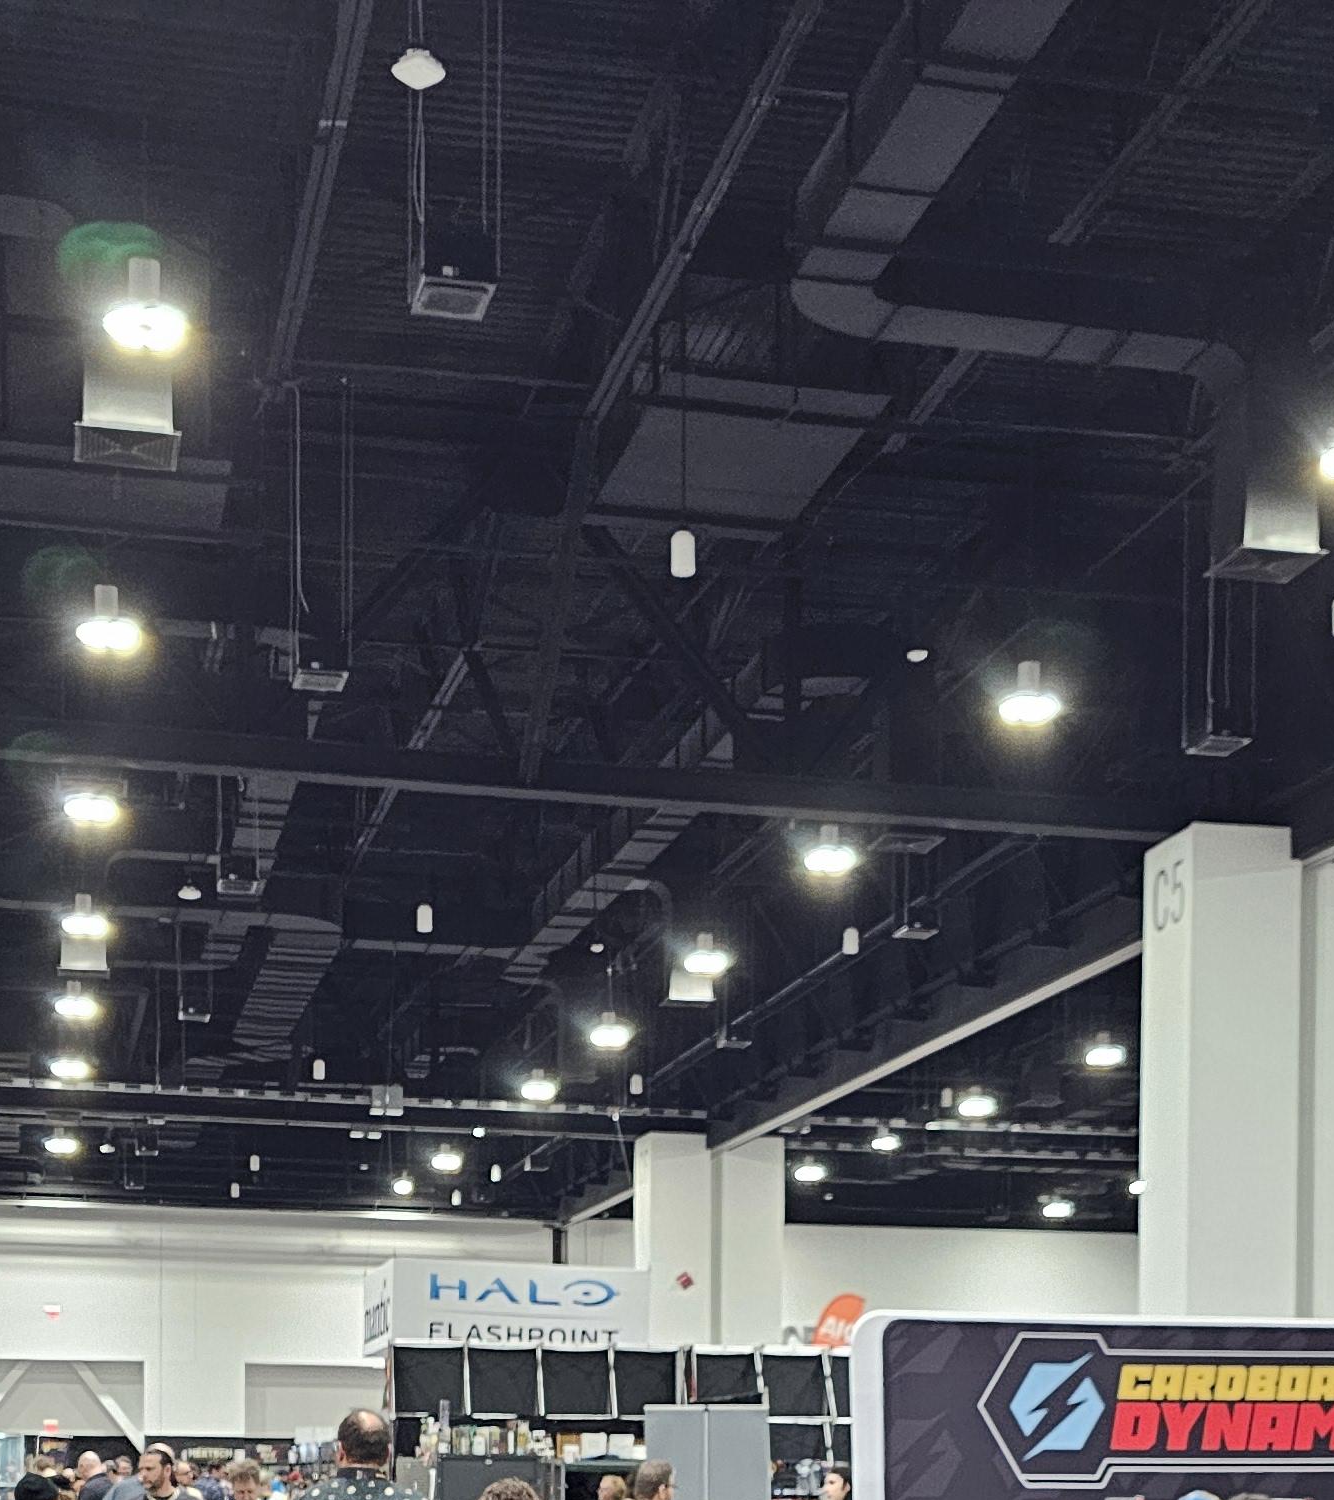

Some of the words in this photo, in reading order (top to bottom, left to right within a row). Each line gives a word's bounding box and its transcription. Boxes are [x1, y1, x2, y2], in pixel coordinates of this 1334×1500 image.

[1152, 859, 1186, 933] C5
[429, 1272, 621, 1307] HALO
[428, 1321, 619, 1344] FLASHPOINT
